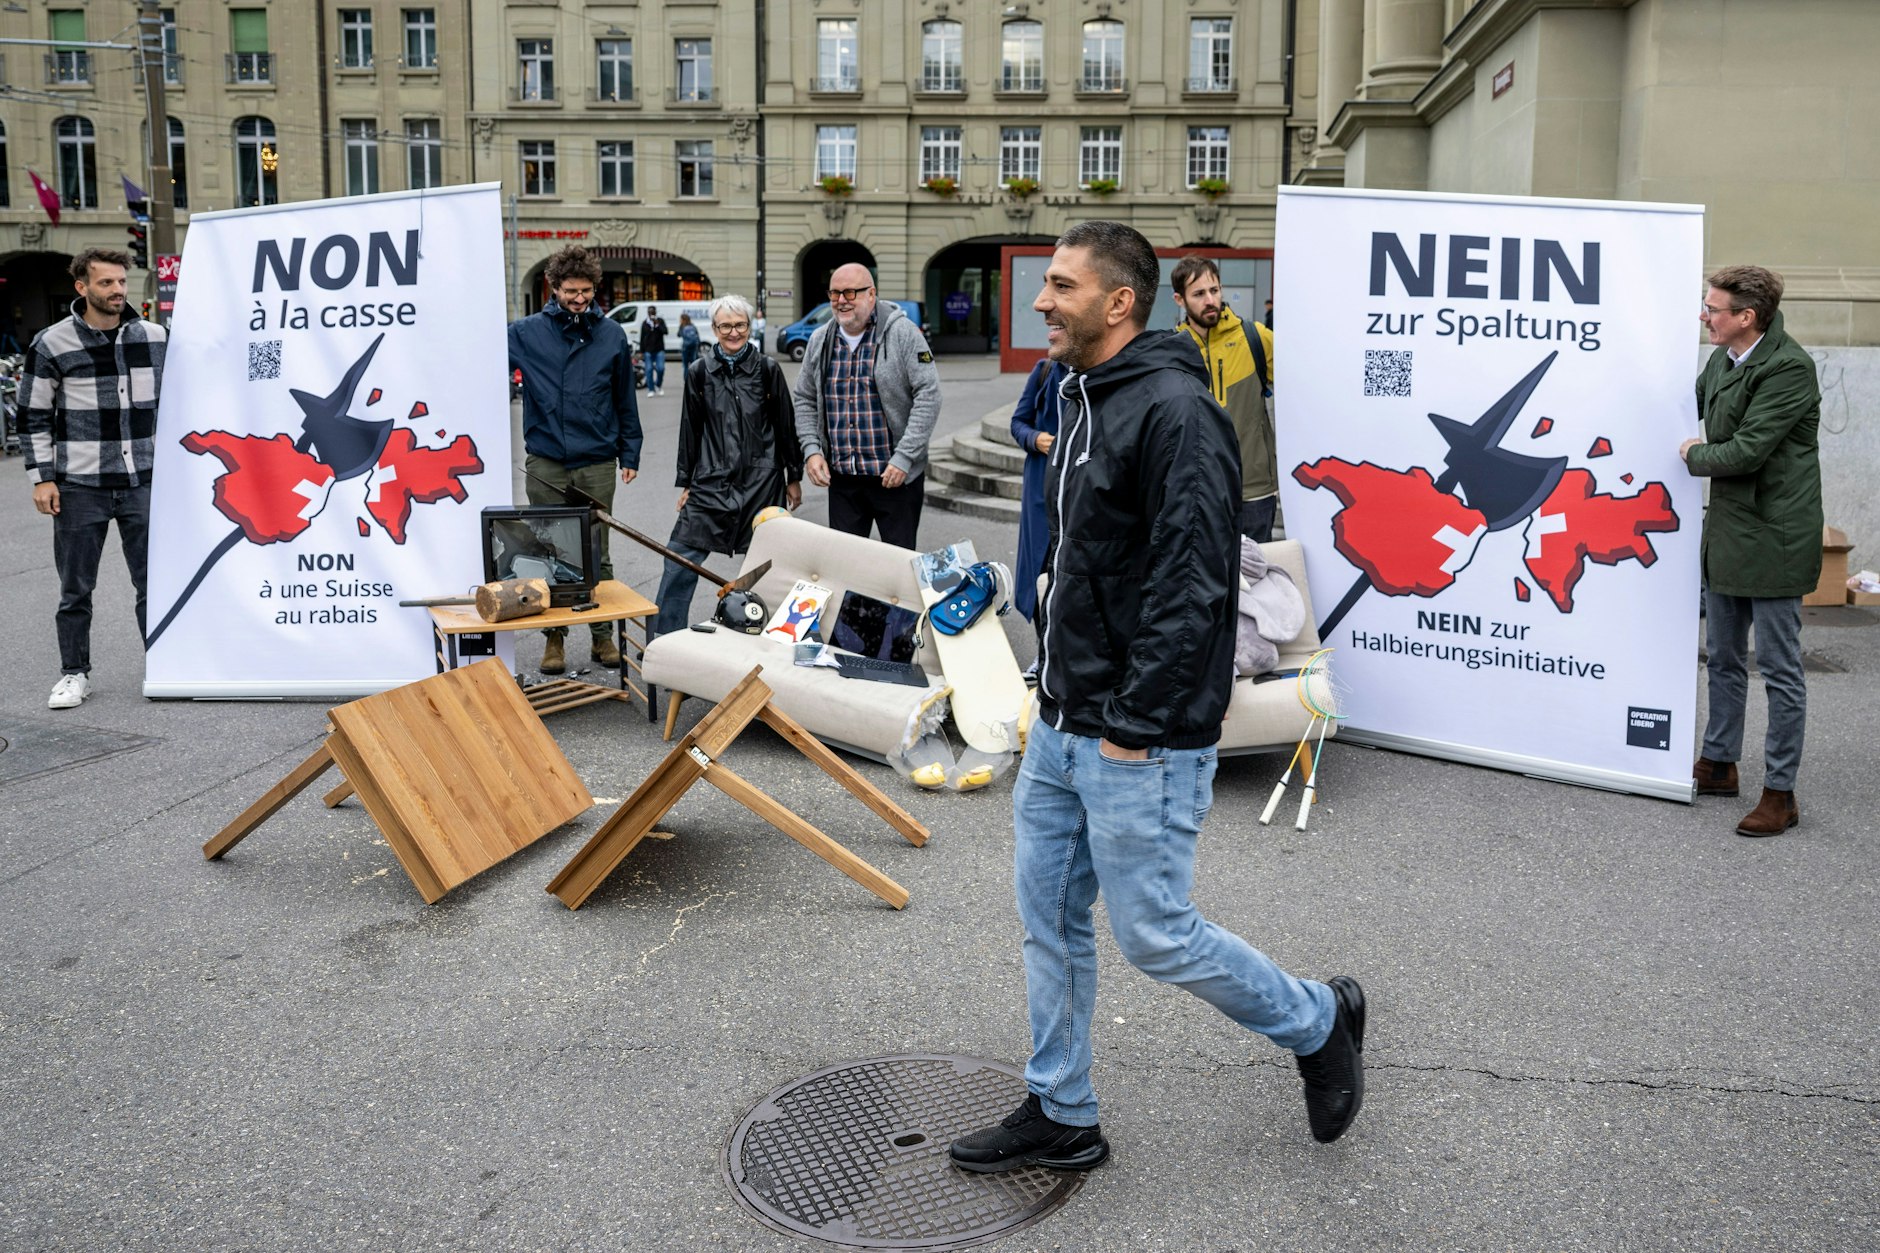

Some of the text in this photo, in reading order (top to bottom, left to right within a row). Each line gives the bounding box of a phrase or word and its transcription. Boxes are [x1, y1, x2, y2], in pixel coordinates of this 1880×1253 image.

[1043, 195, 1083, 204] BANK
[252, 229, 418, 293] NON
[1369, 231, 1600, 305] NEIN
[249, 299, 416, 331] à la casse
[1366, 308, 1601, 351] zur Spaltung
[297, 553, 354, 572] NON
[259, 579, 393, 599] à une Suisse
[275, 605, 377, 625] au rabais
[751, 607, 758, 616] 8
[1417, 610, 1531, 641] NEIN zur
[1351, 630, 1605, 680] Halbierungsinitiative
[1630, 711, 1669, 722] OPERATION
[1630, 719, 1655, 728] LIBERO
